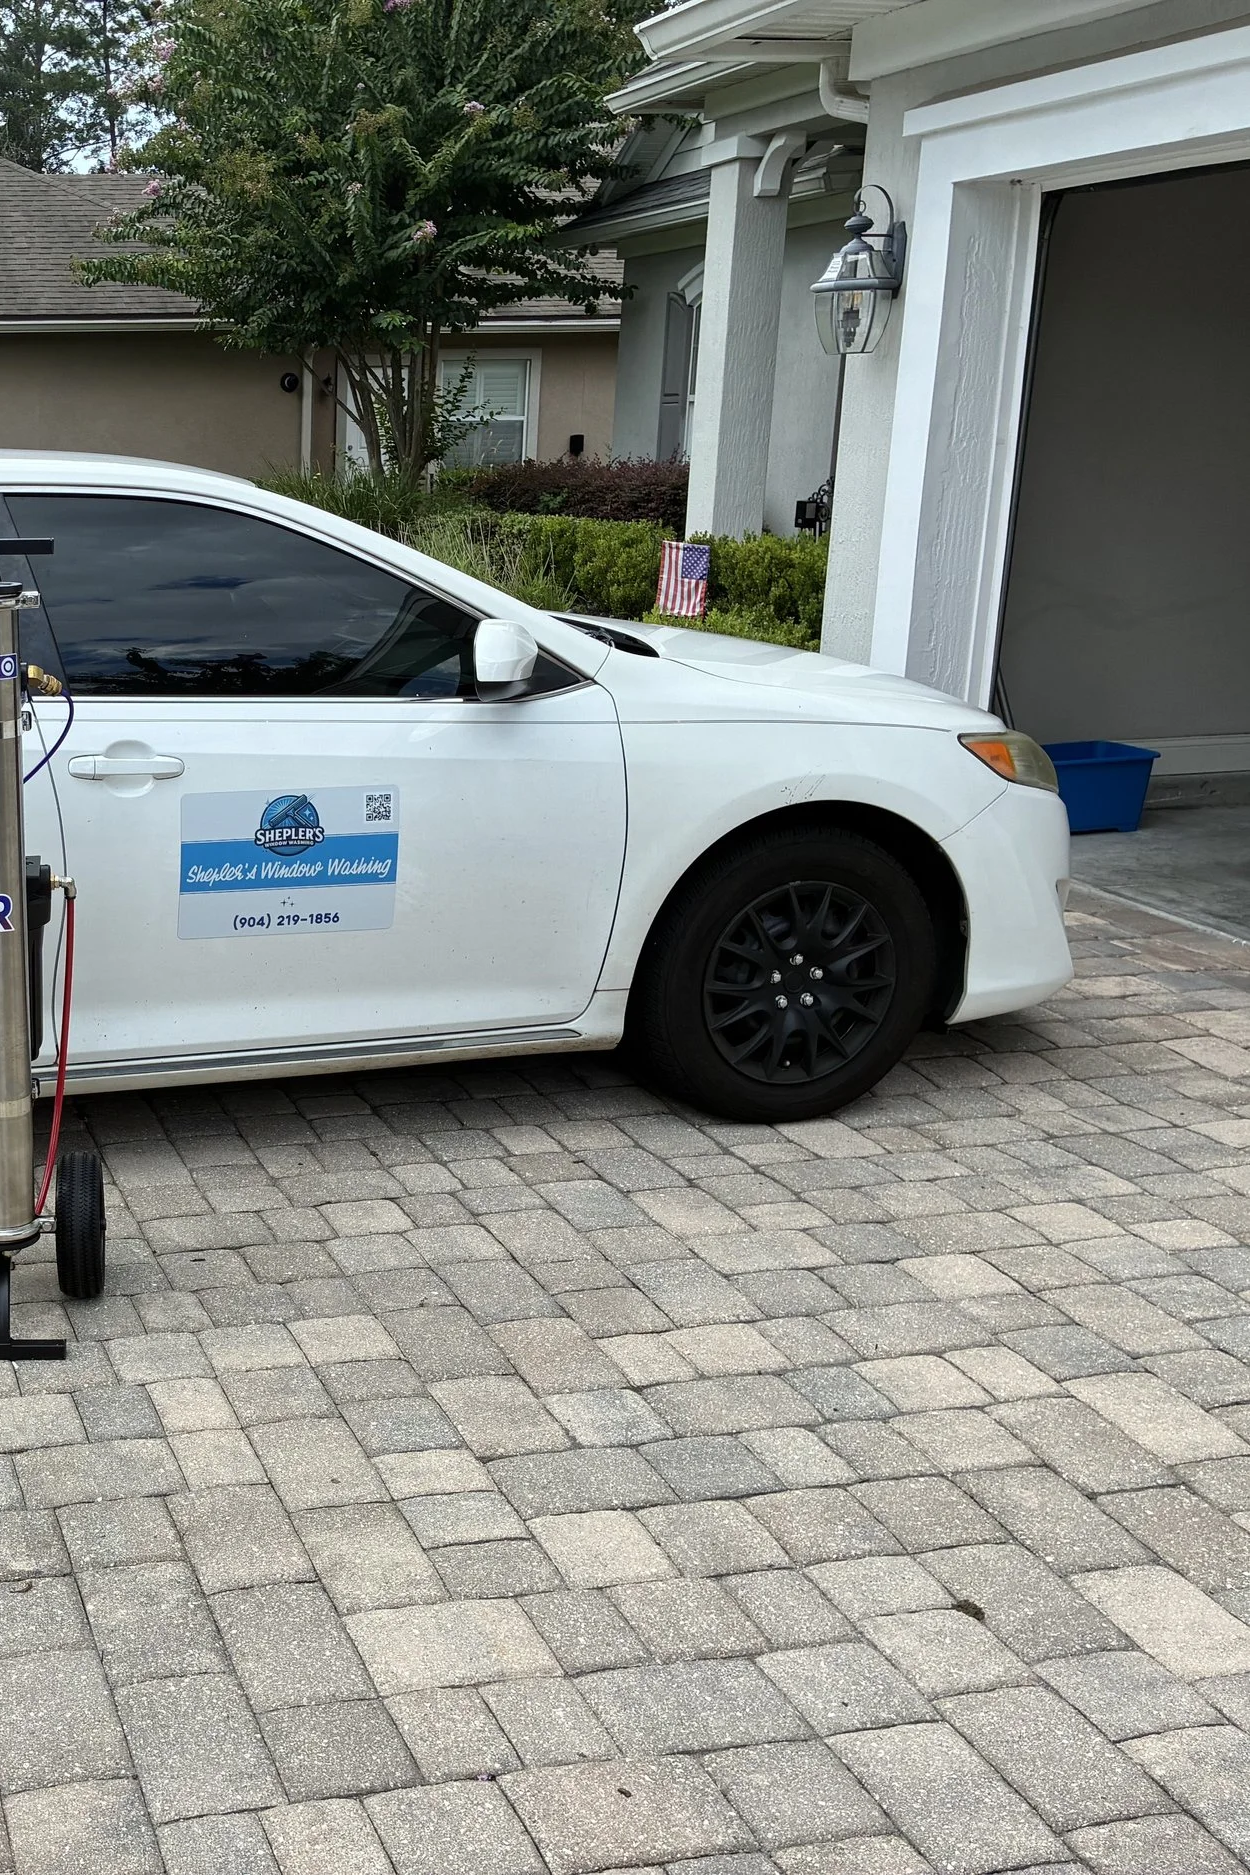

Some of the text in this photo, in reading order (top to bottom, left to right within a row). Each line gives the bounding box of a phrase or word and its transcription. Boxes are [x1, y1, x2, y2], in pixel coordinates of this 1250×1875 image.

[256, 827, 324, 844] SHEPLER'S
[186, 856, 392, 886] Shepler's Window Washing
[233, 912, 340, 931] (904) 219-1856
